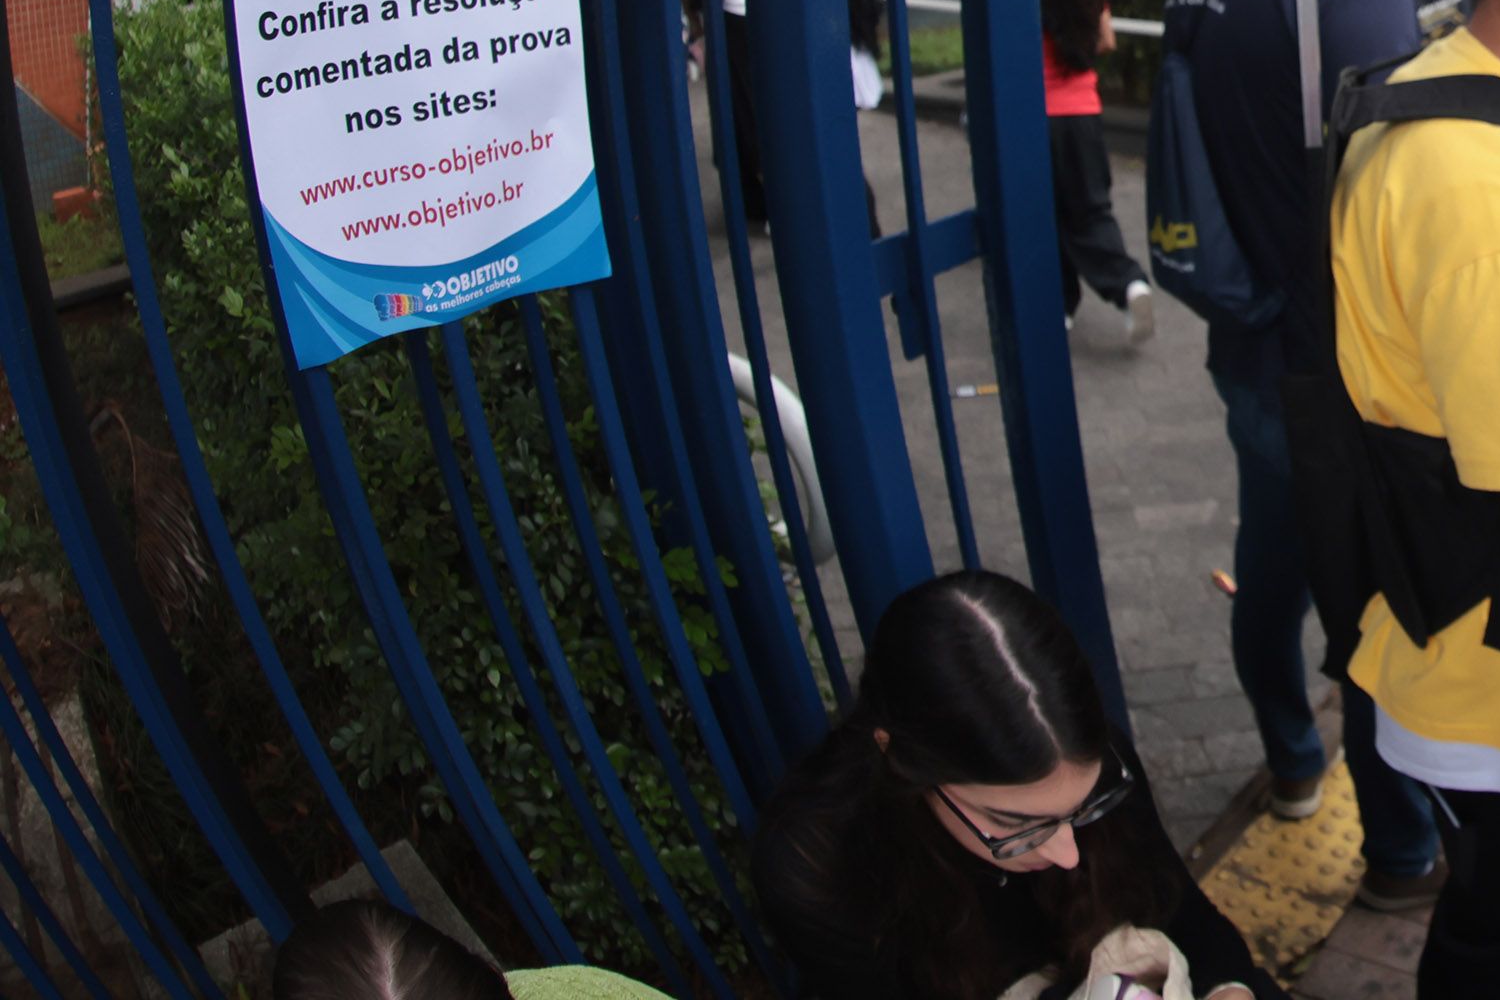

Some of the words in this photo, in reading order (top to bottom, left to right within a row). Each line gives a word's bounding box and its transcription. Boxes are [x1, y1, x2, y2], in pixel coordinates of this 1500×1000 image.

[258, 0, 369, 41] Confira
[256, 43, 432, 99] comentada
[443, 37, 479, 64] da
[490, 27, 572, 64] prova
[345, 104, 402, 133] nos
[412, 88, 497, 124] sites:
[300, 129, 554, 206] www.curso-objetivo.br
[341, 180, 524, 241] www.objetivo.br
[426, 304, 438, 313] as
[440, 290, 484, 310] melhores
[485, 274, 521, 295] cabeças
[447, 255, 519, 295] OBJETIVO
